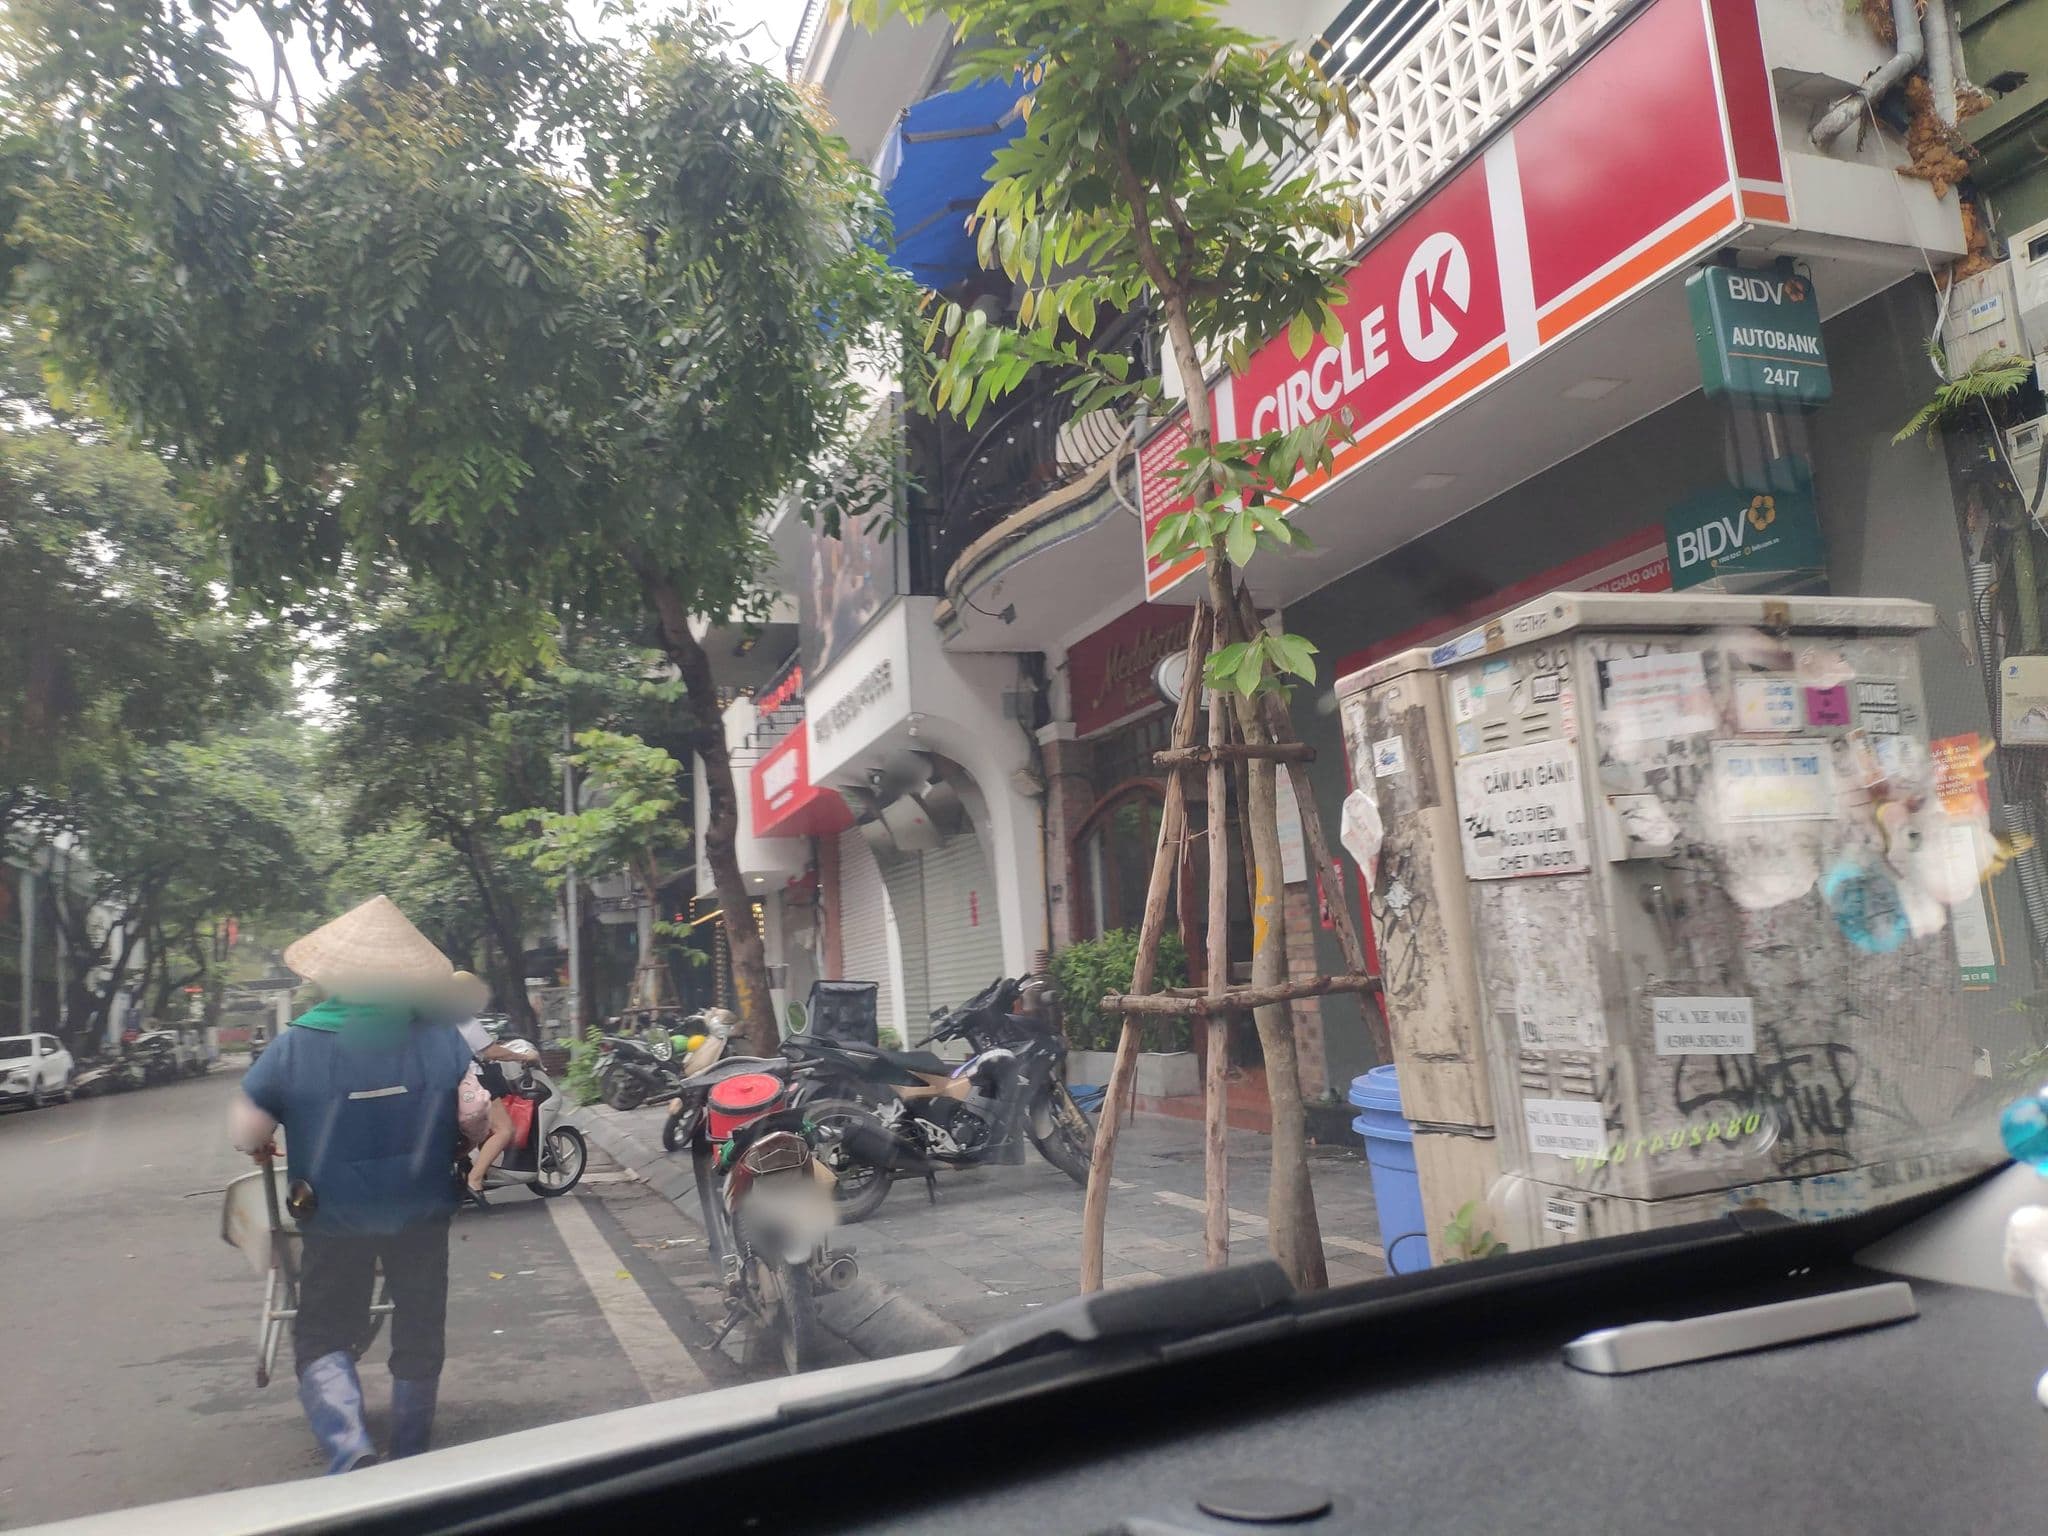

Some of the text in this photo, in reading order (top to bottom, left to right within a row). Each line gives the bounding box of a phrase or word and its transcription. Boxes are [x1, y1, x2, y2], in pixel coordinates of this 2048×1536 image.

[1728, 276, 1784, 305] BIDV
[1252, 242, 1470, 440] CIRCLE K
[1732, 327, 1820, 355] AUTOBANK
[1763, 367, 1799, 387] 24/7
[1677, 508, 1748, 568] BIDV
